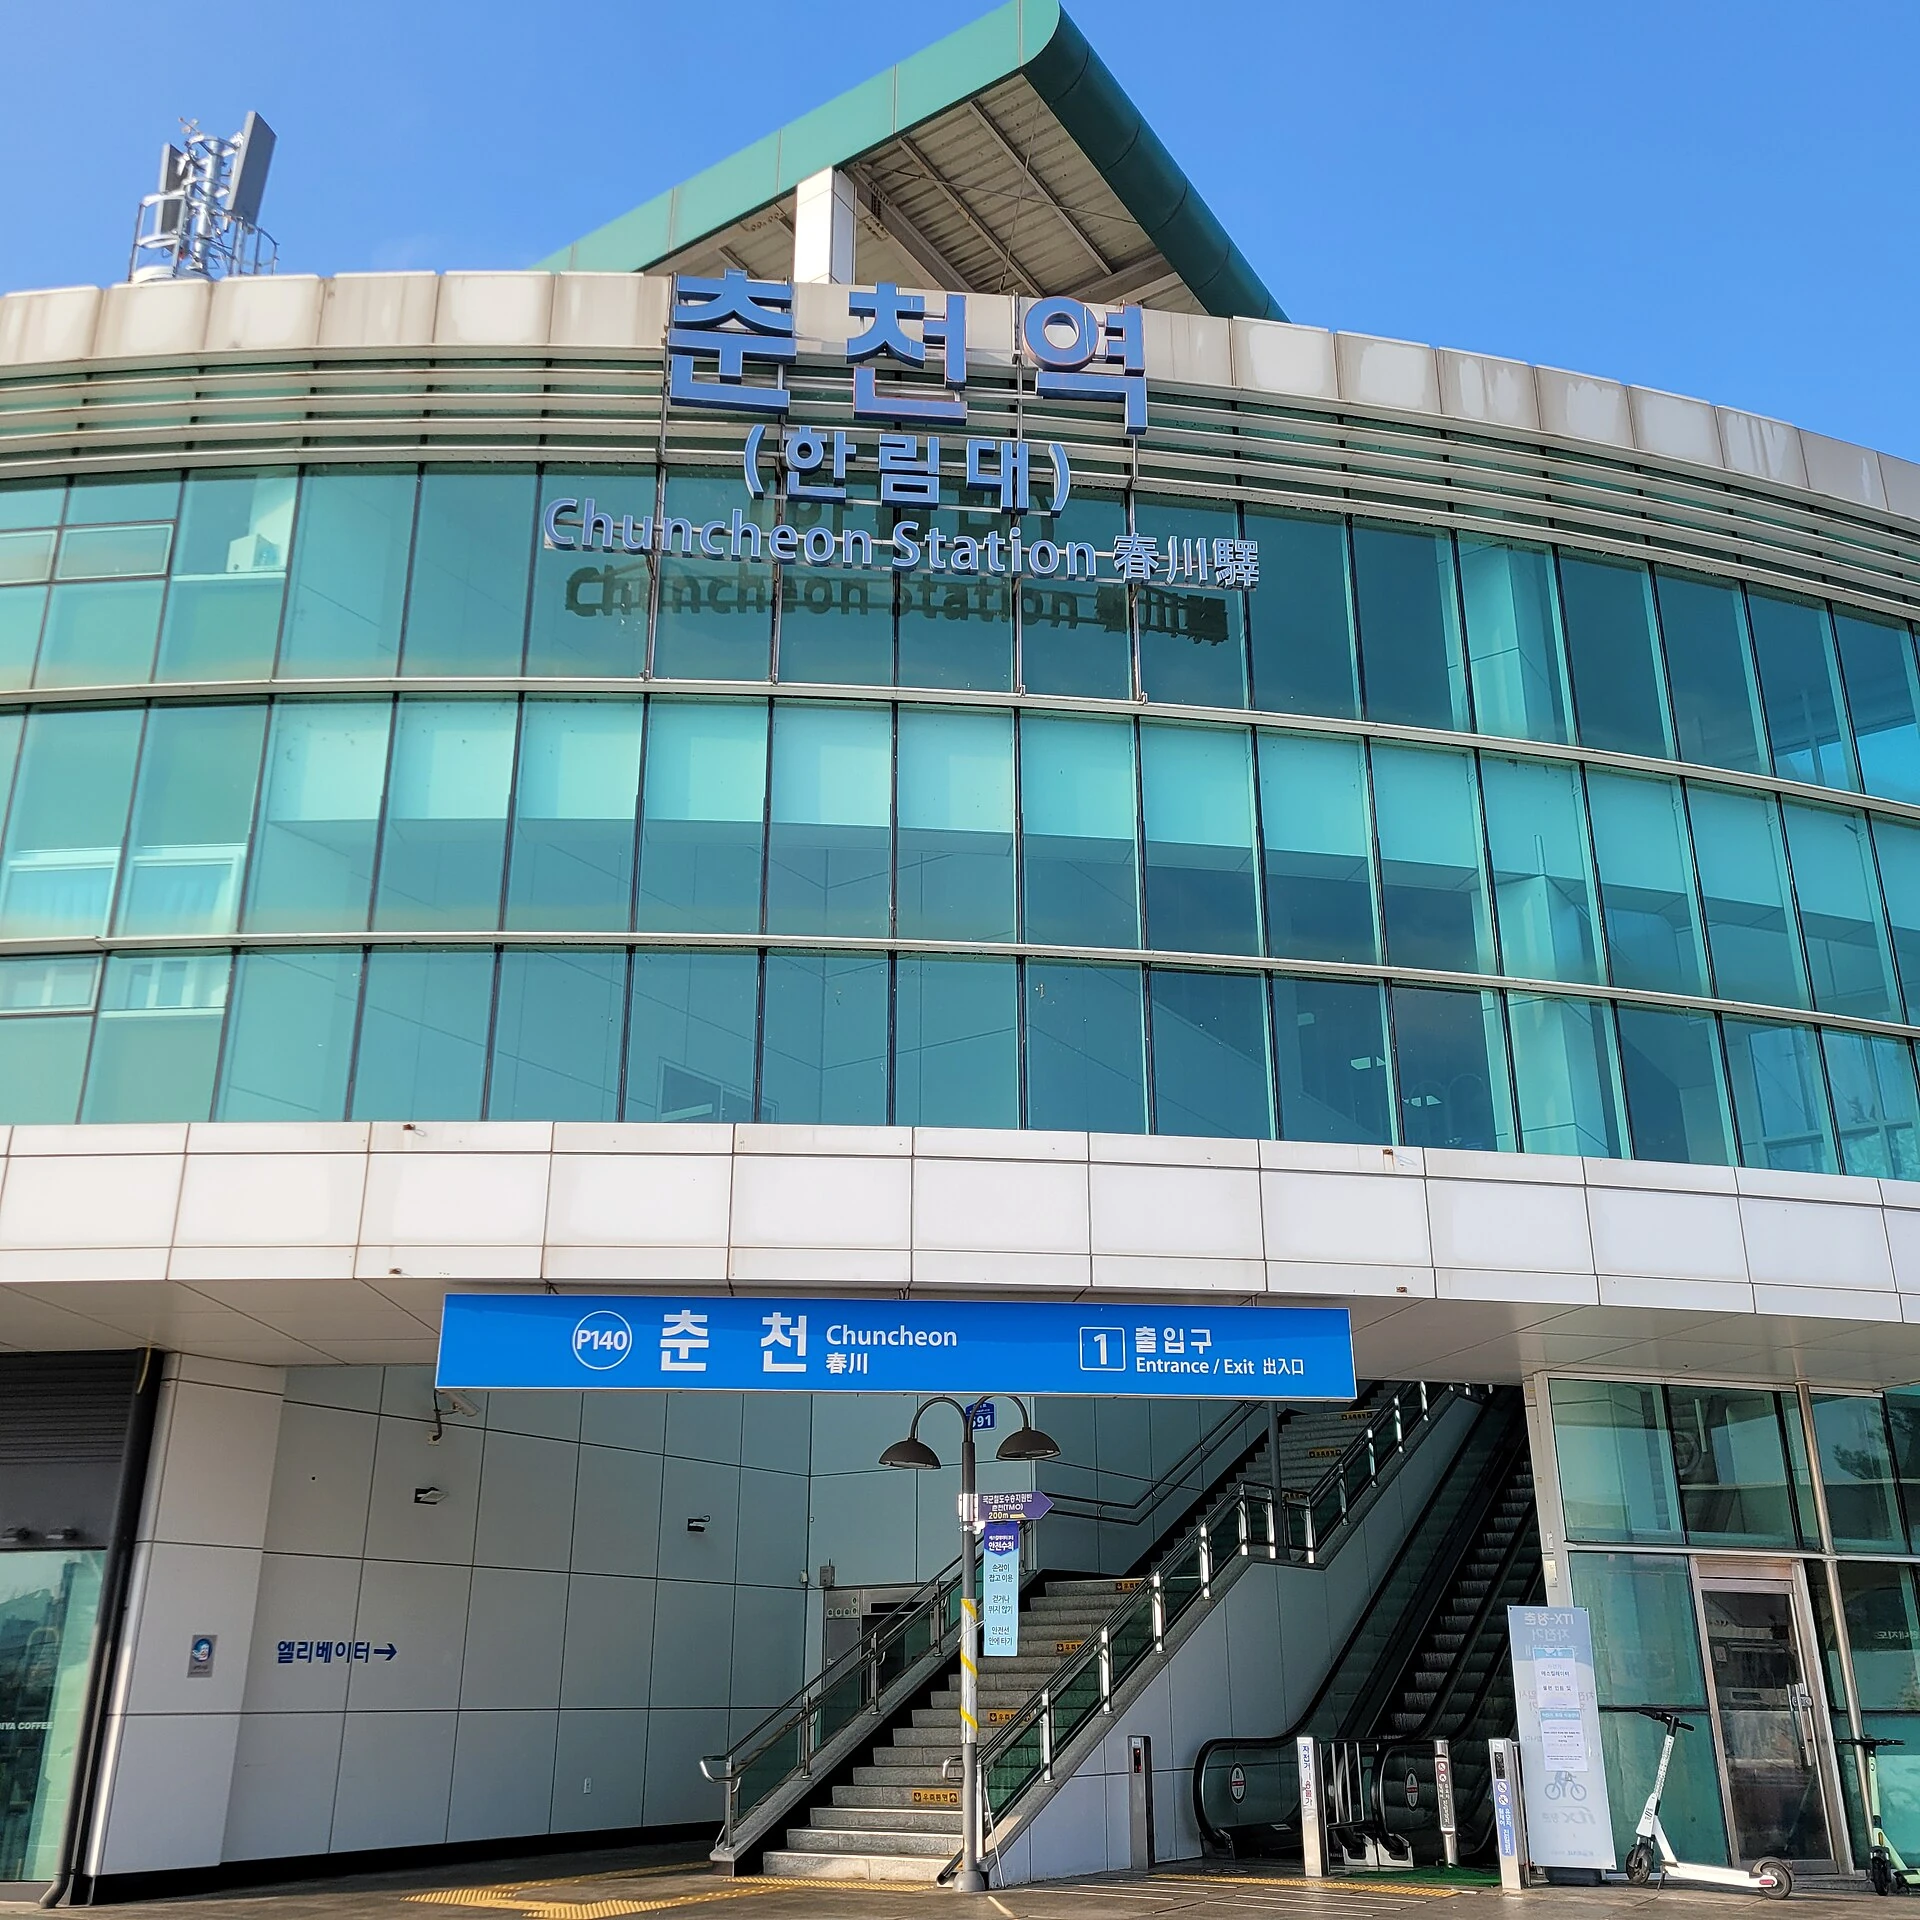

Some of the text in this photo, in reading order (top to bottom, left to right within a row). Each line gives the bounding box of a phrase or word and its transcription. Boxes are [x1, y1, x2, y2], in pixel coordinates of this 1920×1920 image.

[667, 268, 1148, 435] 춘천역
[743, 425, 1071, 516] (한림대)
[543, 498, 1261, 591] Chuncheon Station 春川驛
[575, 1329, 628, 1353] P140
[826, 1323, 958, 1348] Chuncheon
[1134, 1325, 1213, 1355] 출입구
[1092, 1333, 1108, 1366] 1
[825, 1352, 869, 1376] 春川
[1135, 1356, 1210, 1376] Entrance
[1223, 1358, 1255, 1376] Exit
[1262, 1358, 1304, 1377] 出入口
[988, 1512, 1009, 1520] 200m
[988, 1574, 1001, 1583] 잡고
[991, 1563, 1010, 1573] 손잡이
[277, 1639, 371, 1665] 엘리베이터
[18, 1721, 54, 1730] COFFEE
